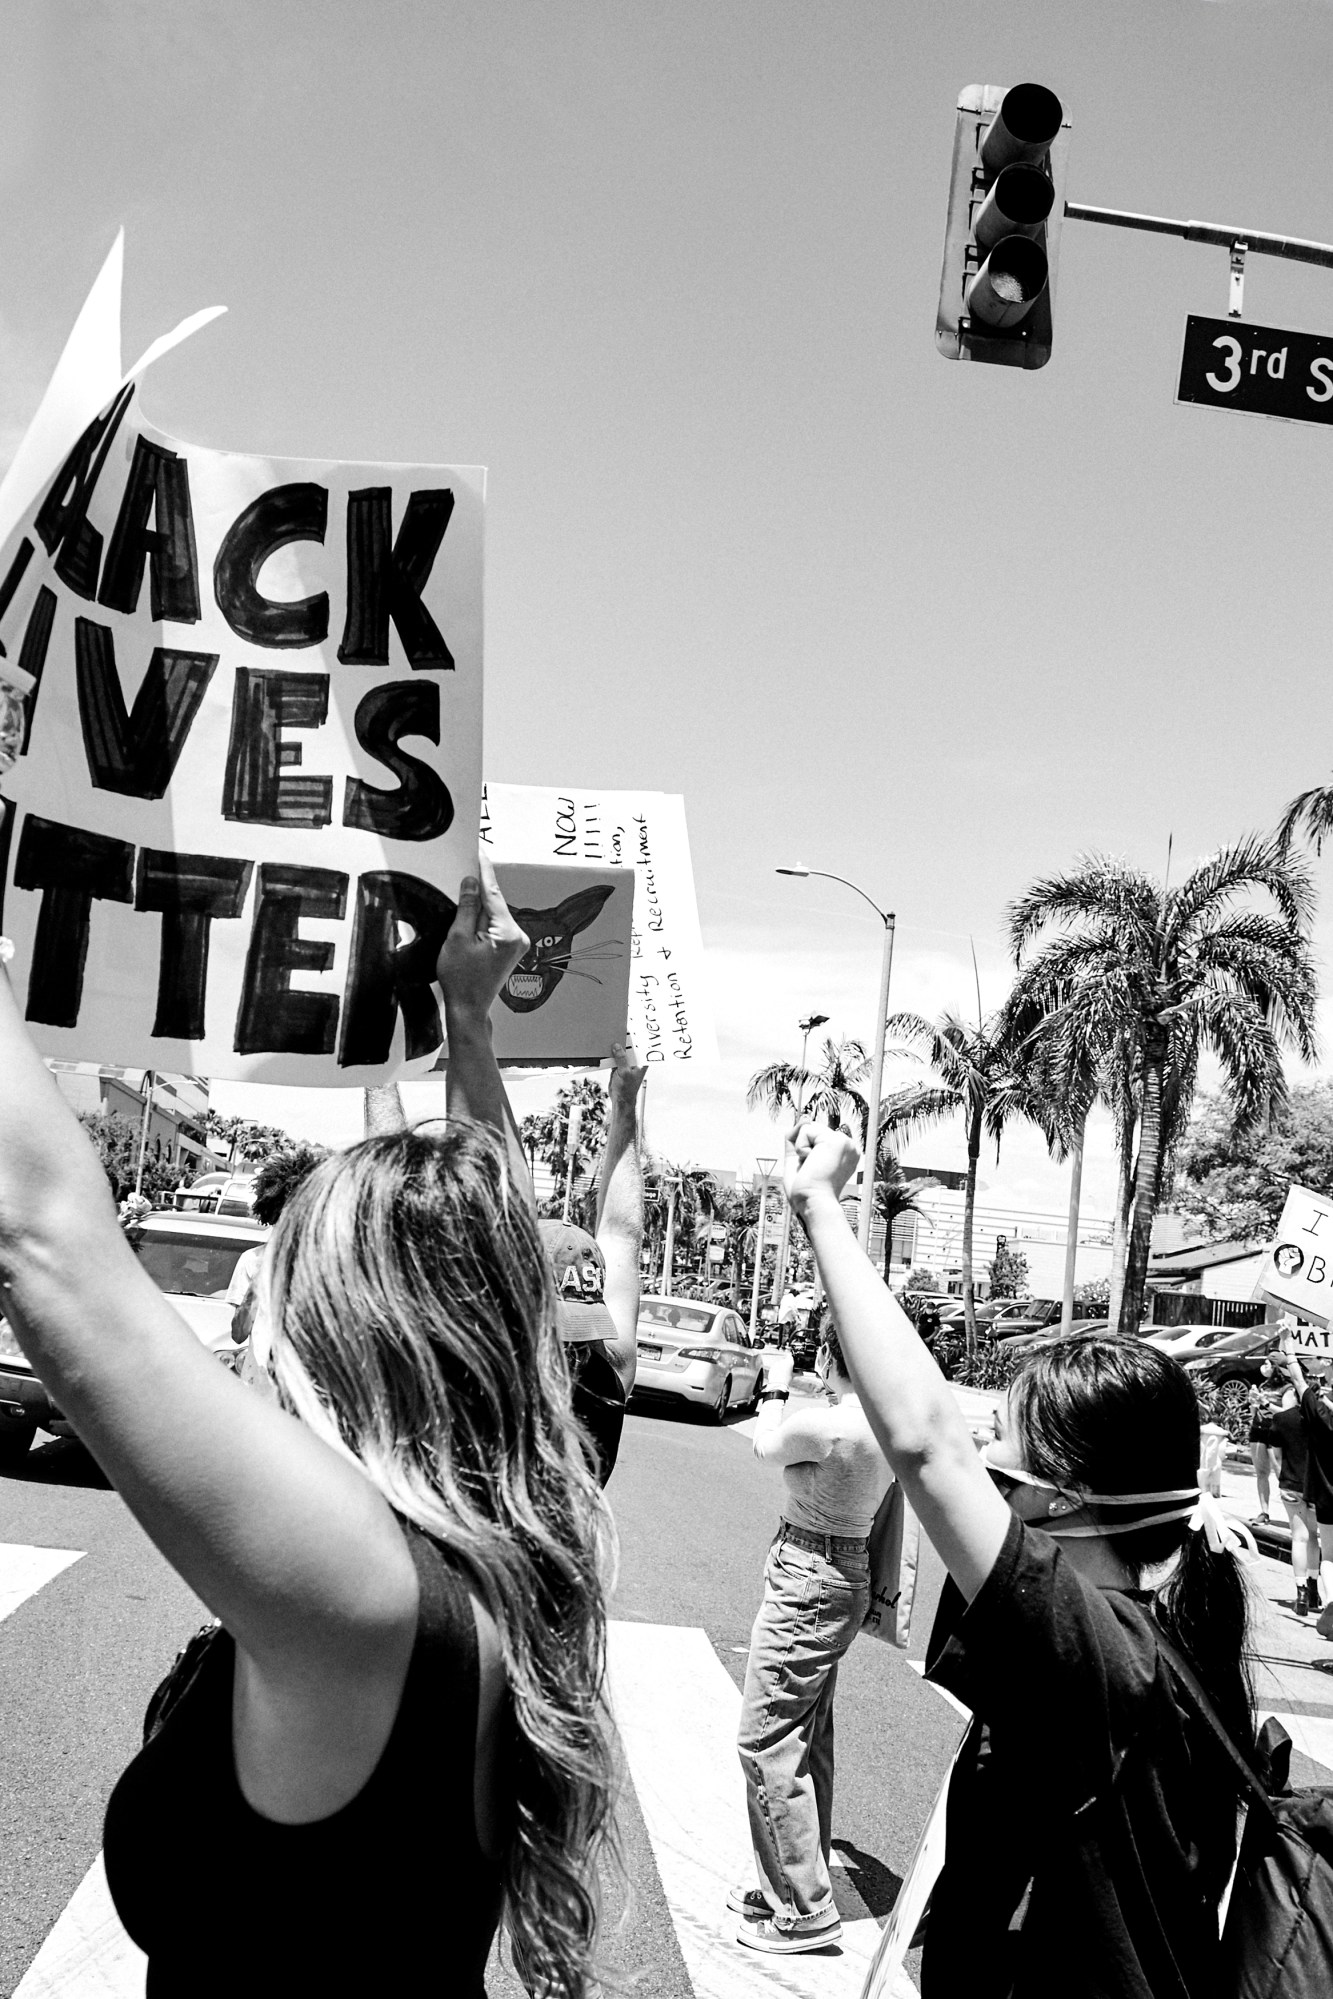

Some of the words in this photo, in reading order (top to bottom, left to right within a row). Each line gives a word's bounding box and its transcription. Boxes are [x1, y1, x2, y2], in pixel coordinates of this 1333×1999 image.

[1205, 335, 1288, 393] 3rd
[552, 797, 577, 857] NOW
[609, 826, 626, 866] tion,
[632, 812, 665, 933] Recruitment
[635, 975, 665, 1062] Diversity
